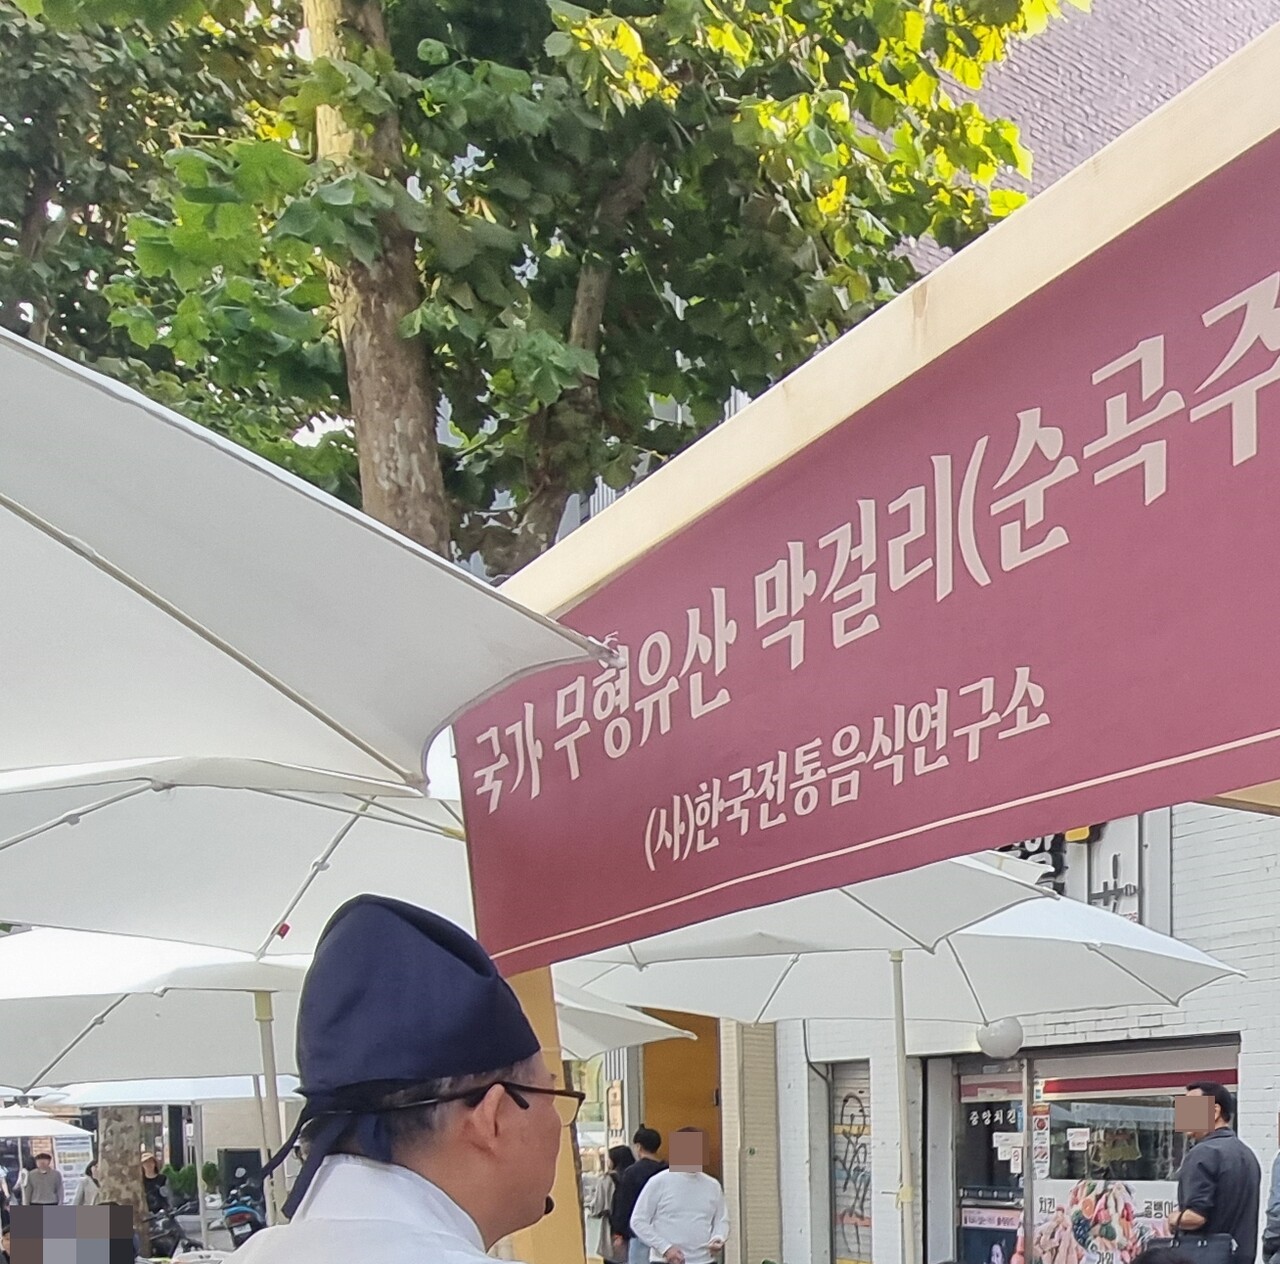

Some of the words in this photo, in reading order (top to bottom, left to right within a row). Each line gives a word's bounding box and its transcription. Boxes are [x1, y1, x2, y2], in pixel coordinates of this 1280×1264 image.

[474, 702, 543, 815] 국가
[554, 587, 737, 780] 무형유산
[643, 666, 1050, 871] (사)한국전통음식연구소
